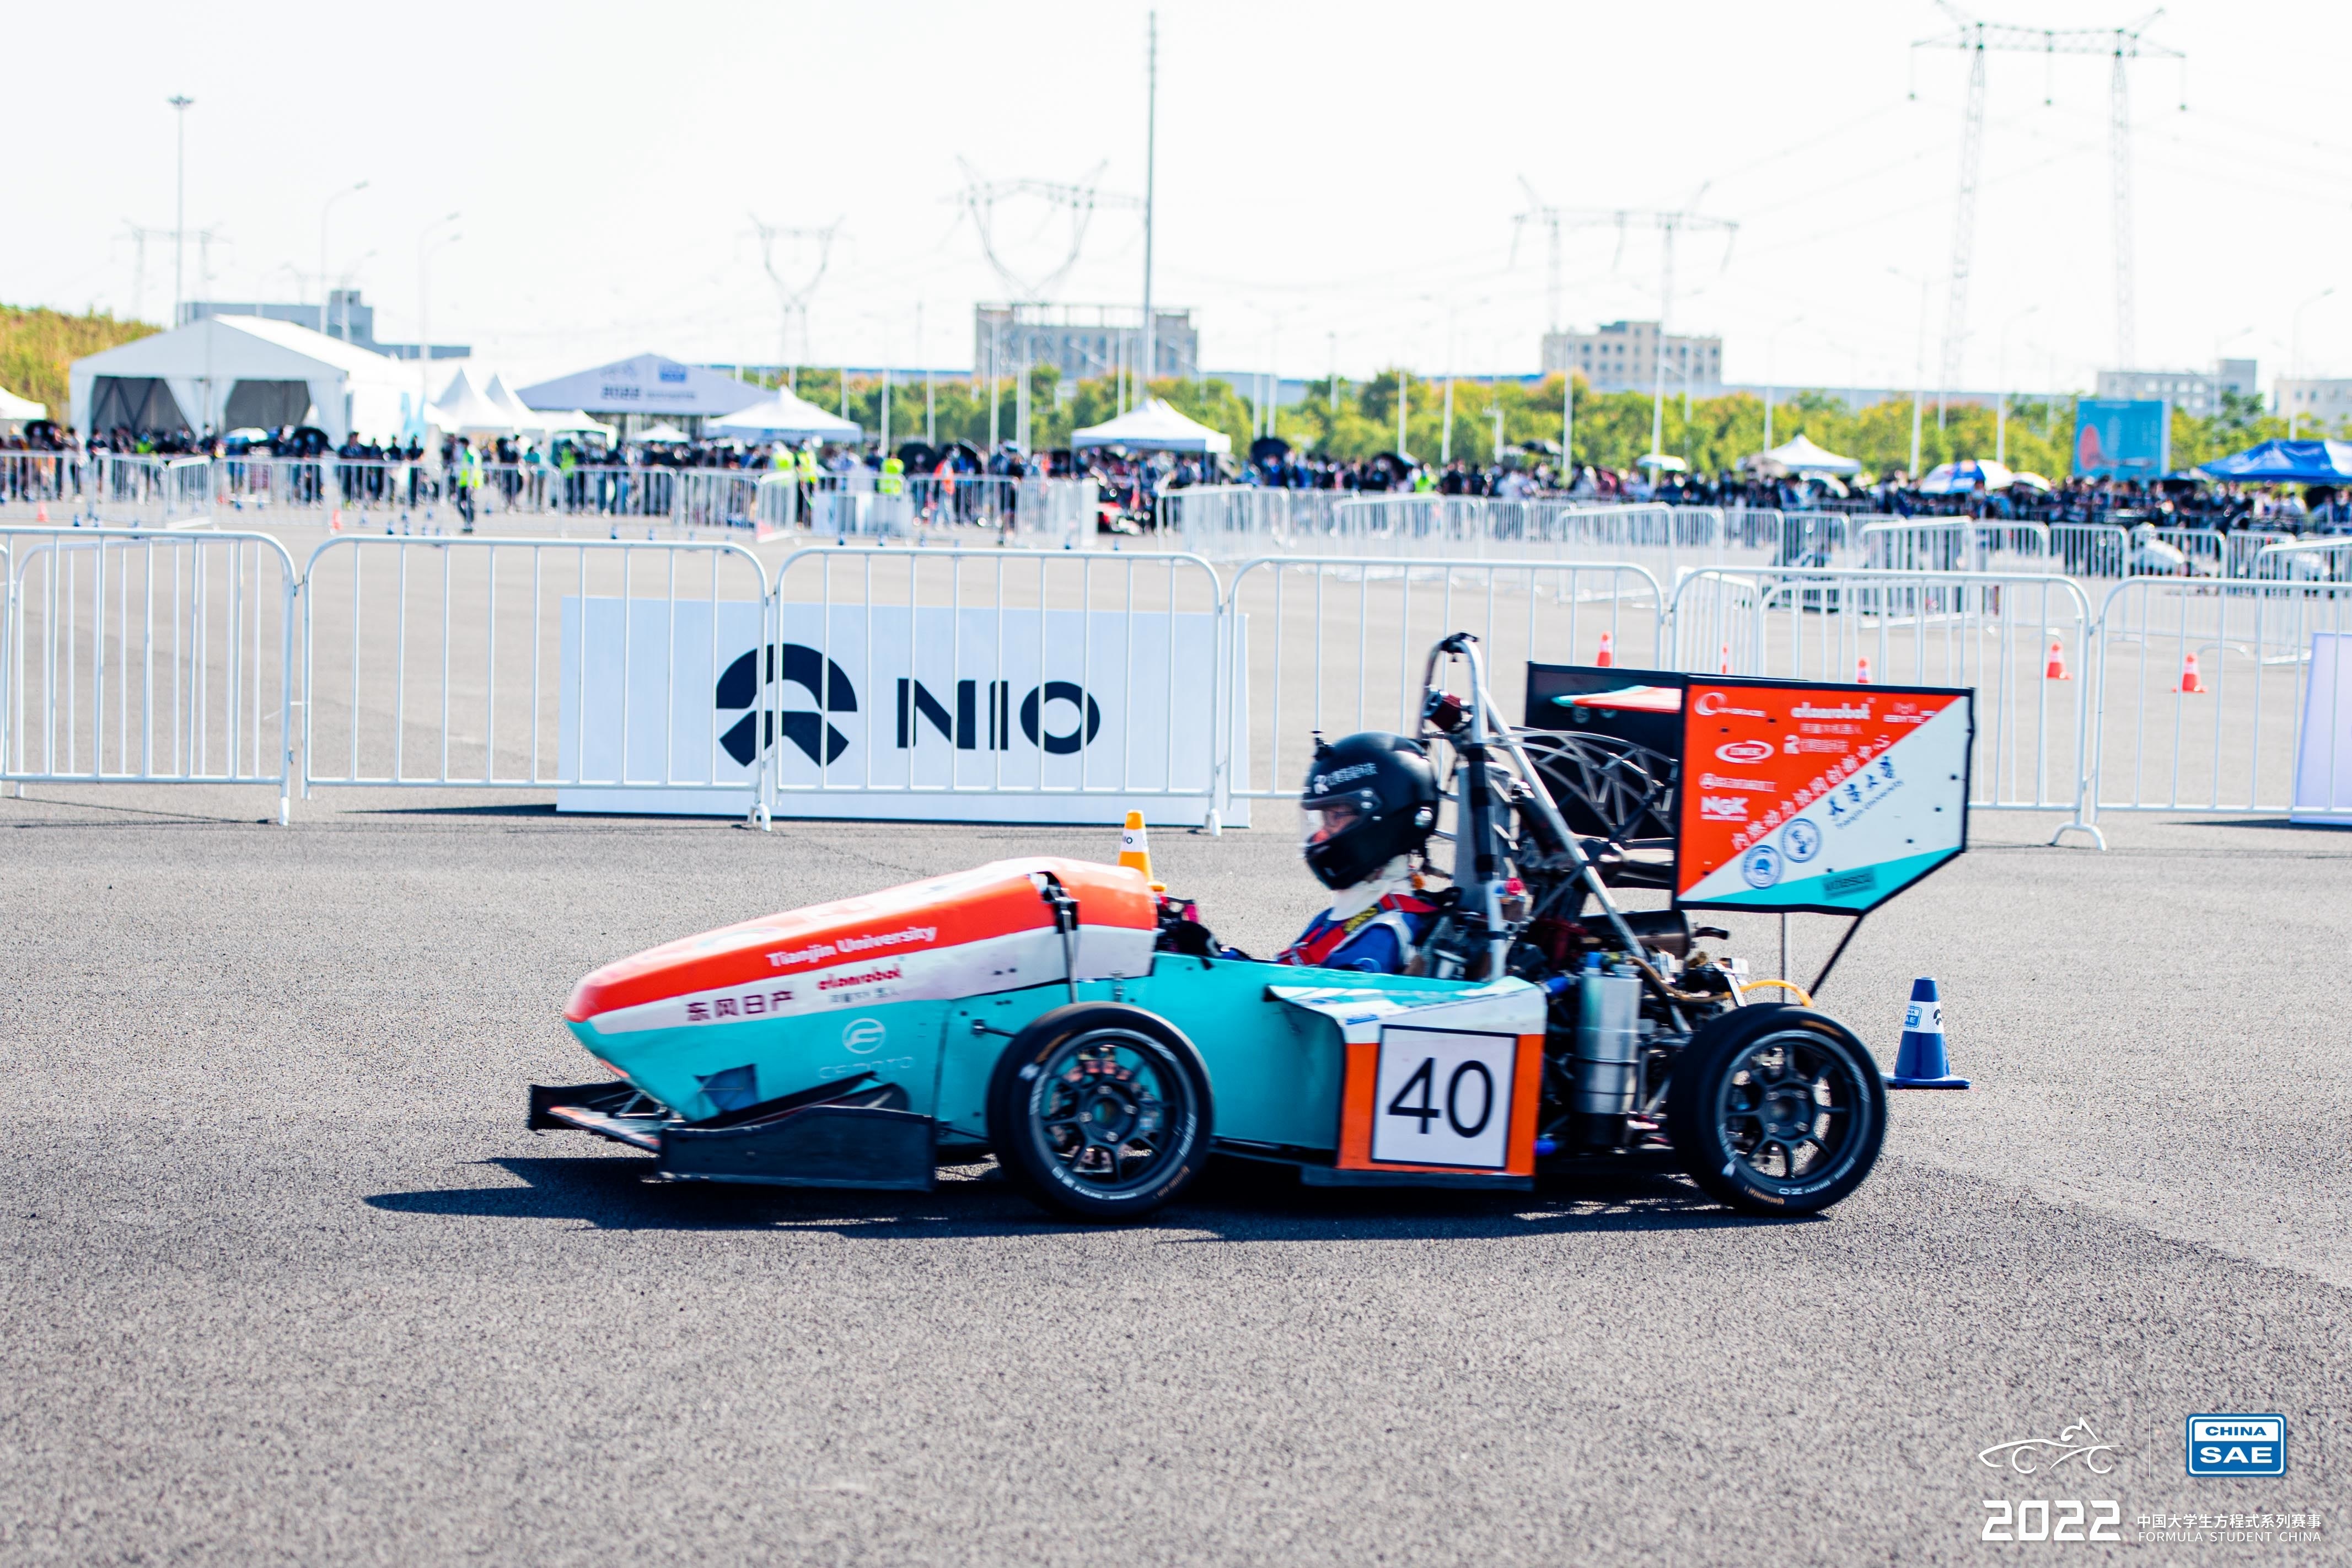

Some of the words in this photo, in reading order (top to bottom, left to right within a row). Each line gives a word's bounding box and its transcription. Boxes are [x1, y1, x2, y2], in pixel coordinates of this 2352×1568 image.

[897, 678, 1100, 754] NIO
[1700, 796, 1749, 815] NGK
[766, 944, 837, 967] Tianjin
[835, 926, 937, 953] University
[686, 990, 794, 1021] 东风日产
[1387, 1057, 1494, 1139] 40
